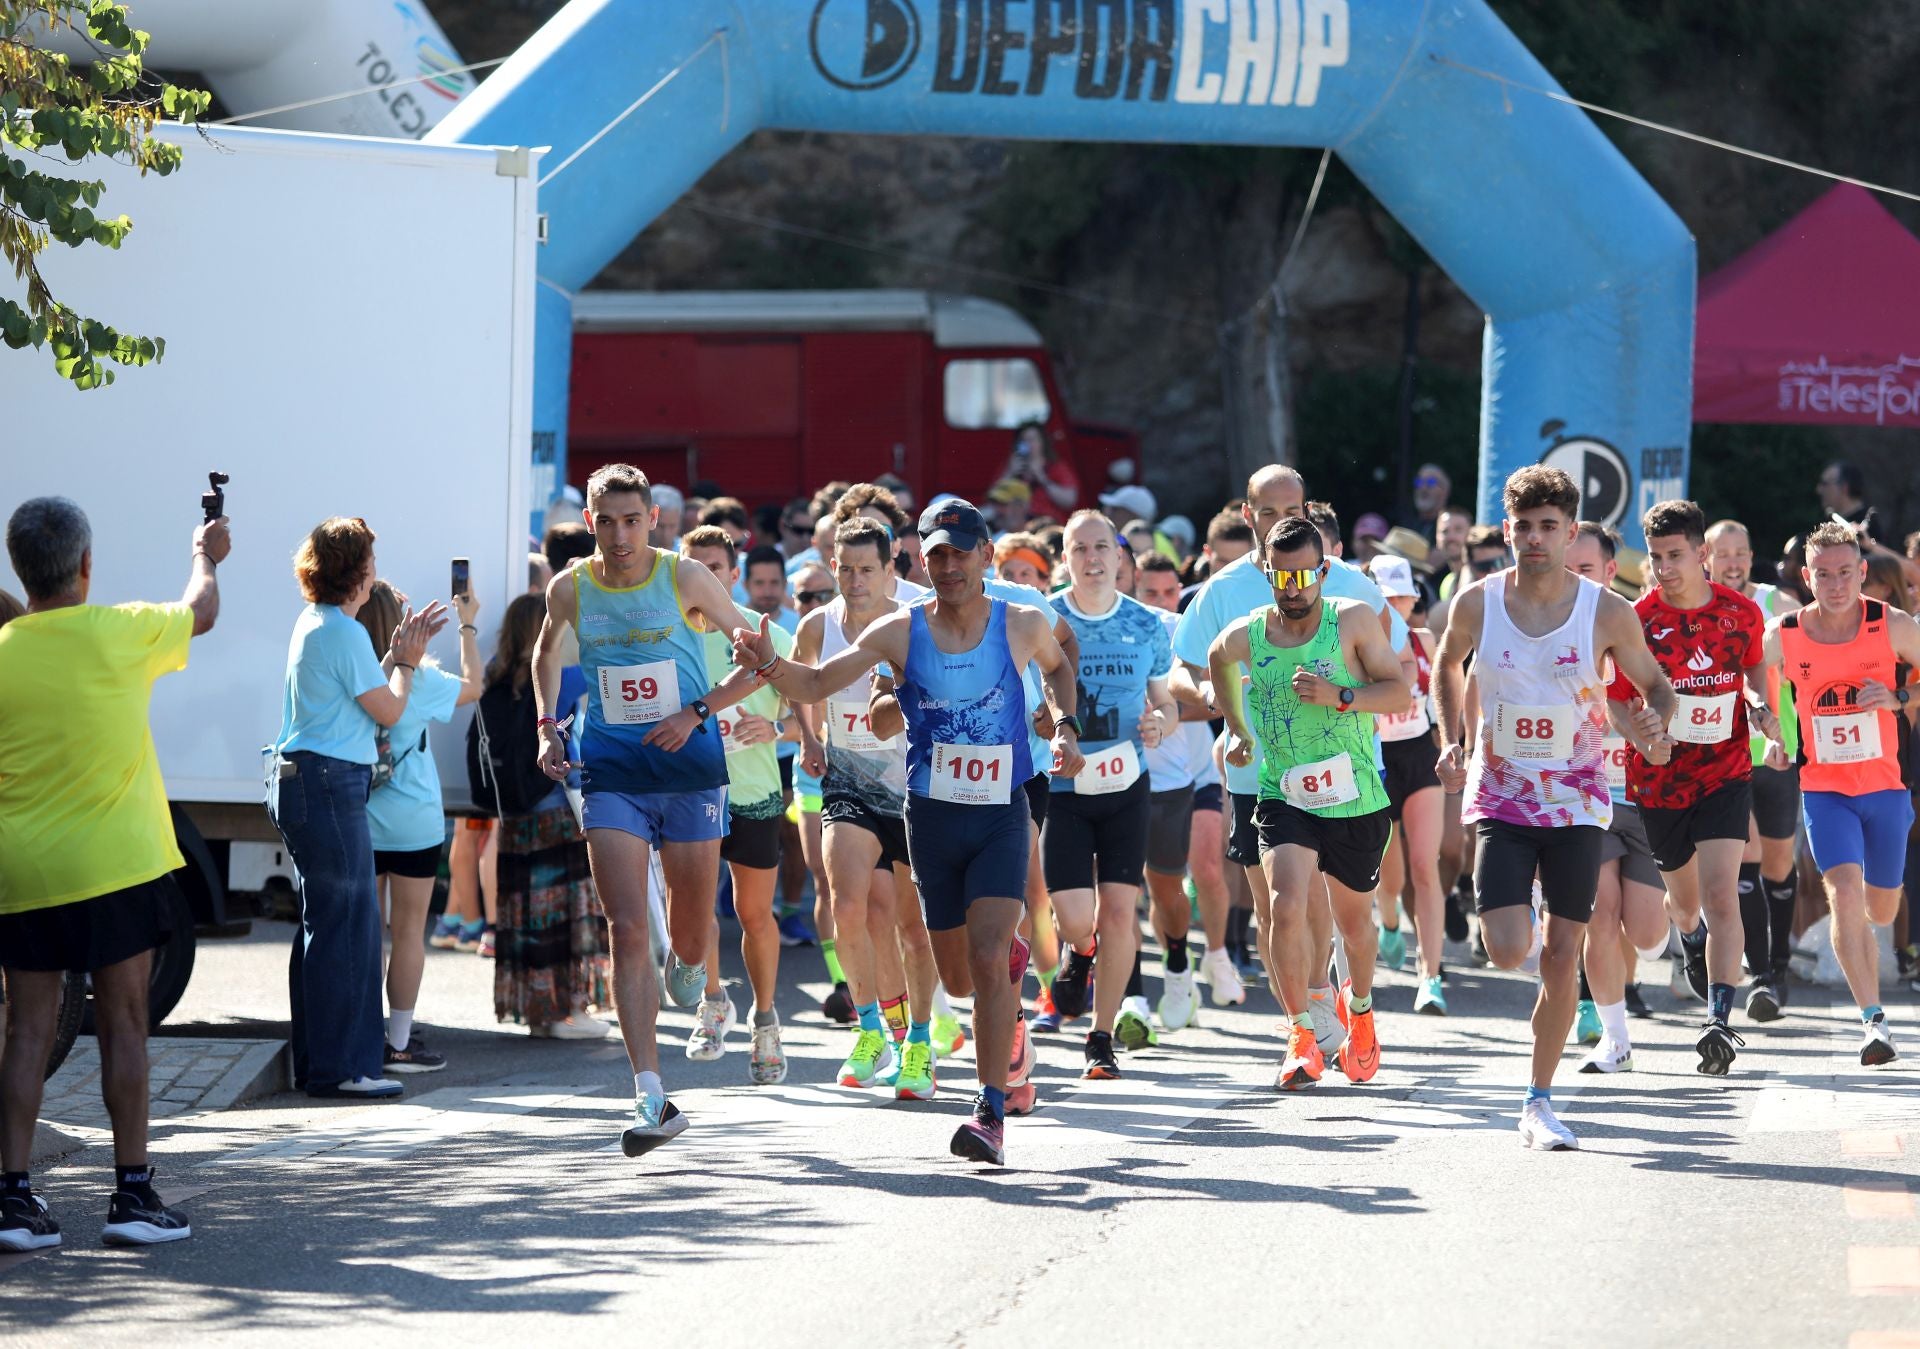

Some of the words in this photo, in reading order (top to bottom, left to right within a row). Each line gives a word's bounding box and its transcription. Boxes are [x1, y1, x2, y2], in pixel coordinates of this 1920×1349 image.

[1080, 660, 1134, 676] OFRÍN
[602, 669, 610, 699] CARRERA
[621, 677, 658, 702] 59
[843, 713, 872, 732] 71
[1690, 706, 1722, 726] 84
[1515, 718, 1554, 740] 88
[1832, 724, 1861, 745] 51
[936, 746, 944, 774] CARRERA
[947, 756, 1000, 782] 101
[1095, 757, 1124, 778] 10
[1302, 769, 1333, 793] 81
